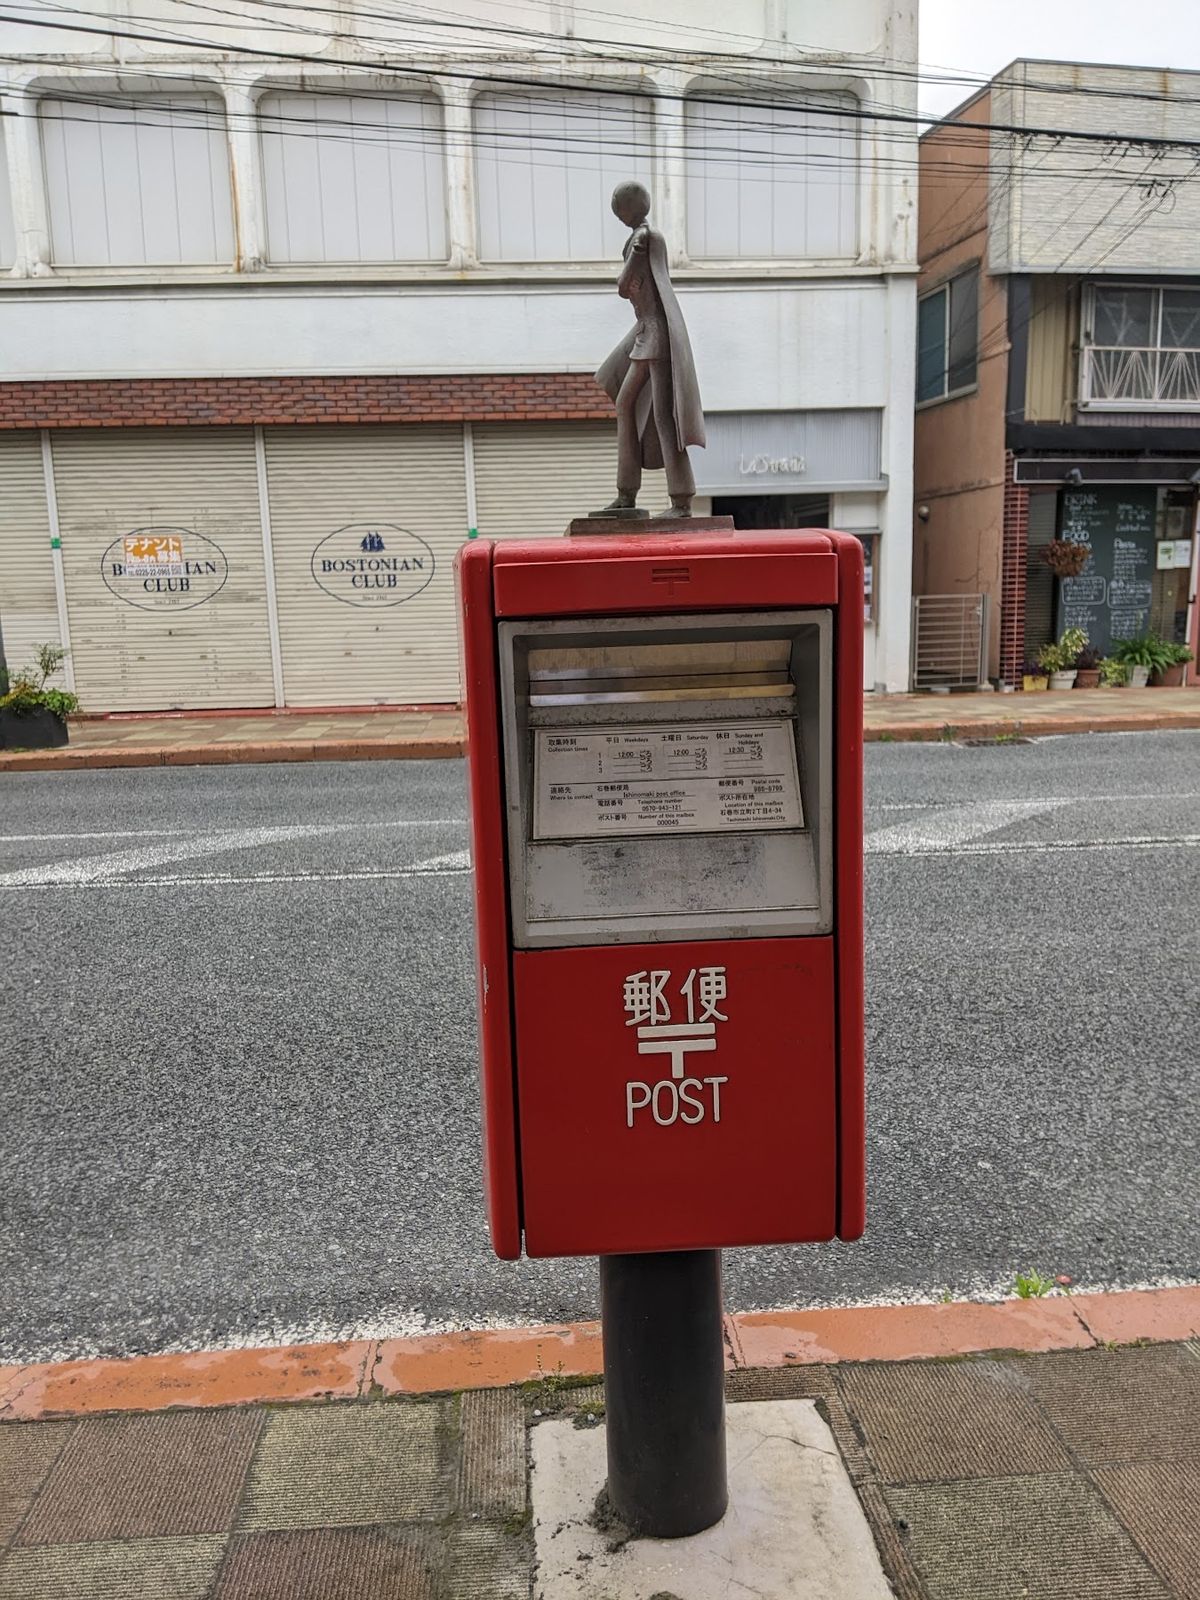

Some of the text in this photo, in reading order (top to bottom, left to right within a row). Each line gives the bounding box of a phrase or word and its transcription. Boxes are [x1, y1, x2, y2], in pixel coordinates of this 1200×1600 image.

[125, 538, 179, 551] テナント
[322, 557, 424, 572] BOSTONIAN
[143, 577, 190, 592] CLUB
[351, 573, 398, 588] CLUB
[661, 734, 682, 742] 土曜日
[716, 732, 730, 740] 休日
[734, 732, 753, 740] Sunday
[718, 779, 744, 787] 郵便番号
[550, 786, 572, 794] 連絡先
[597, 784, 630, 792] 石巻郵便局
[623, 791, 655, 799] Ishinomaki
[656, 791, 669, 799] post
[597, 799, 624, 807] 電話番号
[598, 813, 628, 822] ポスト番号
[656, 819, 680, 827] 000045
[623, 966, 729, 1027] 郵便
[625, 1076, 729, 1128] POST
